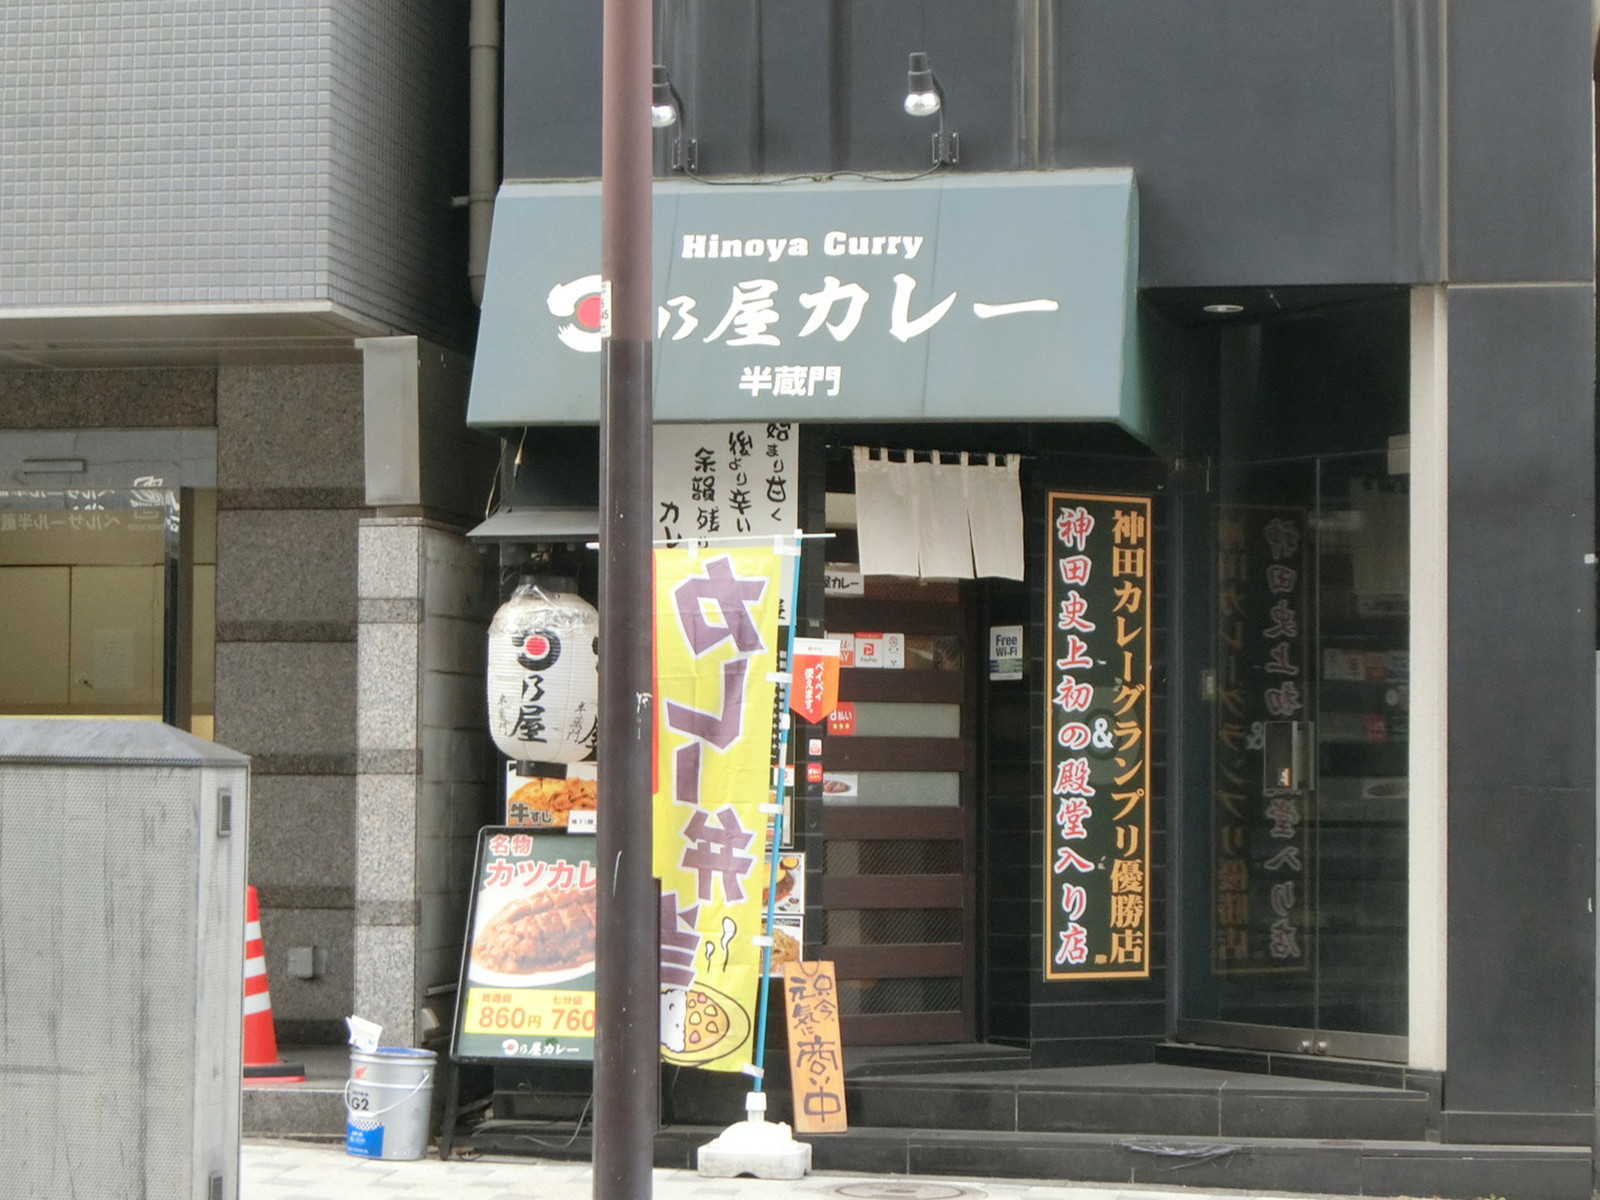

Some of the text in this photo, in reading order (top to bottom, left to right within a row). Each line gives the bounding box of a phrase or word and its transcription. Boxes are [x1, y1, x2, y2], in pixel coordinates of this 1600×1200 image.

[682, 231, 924, 261] Hinoya Curry
[738, 364, 842, 398] 半蔵門
[996, 634, 1018, 646] Free
[996, 646, 1018, 657] Wi-Fi
[1052, 506, 1096, 965] 神田史上初の殿堂入り店
[1093, 717, 1112, 749] &
[1110, 509, 1146, 965] 神田カレーグランプリ優勝店
[489, 834, 533, 856] 名物
[351, 1097, 369, 1112] G2
